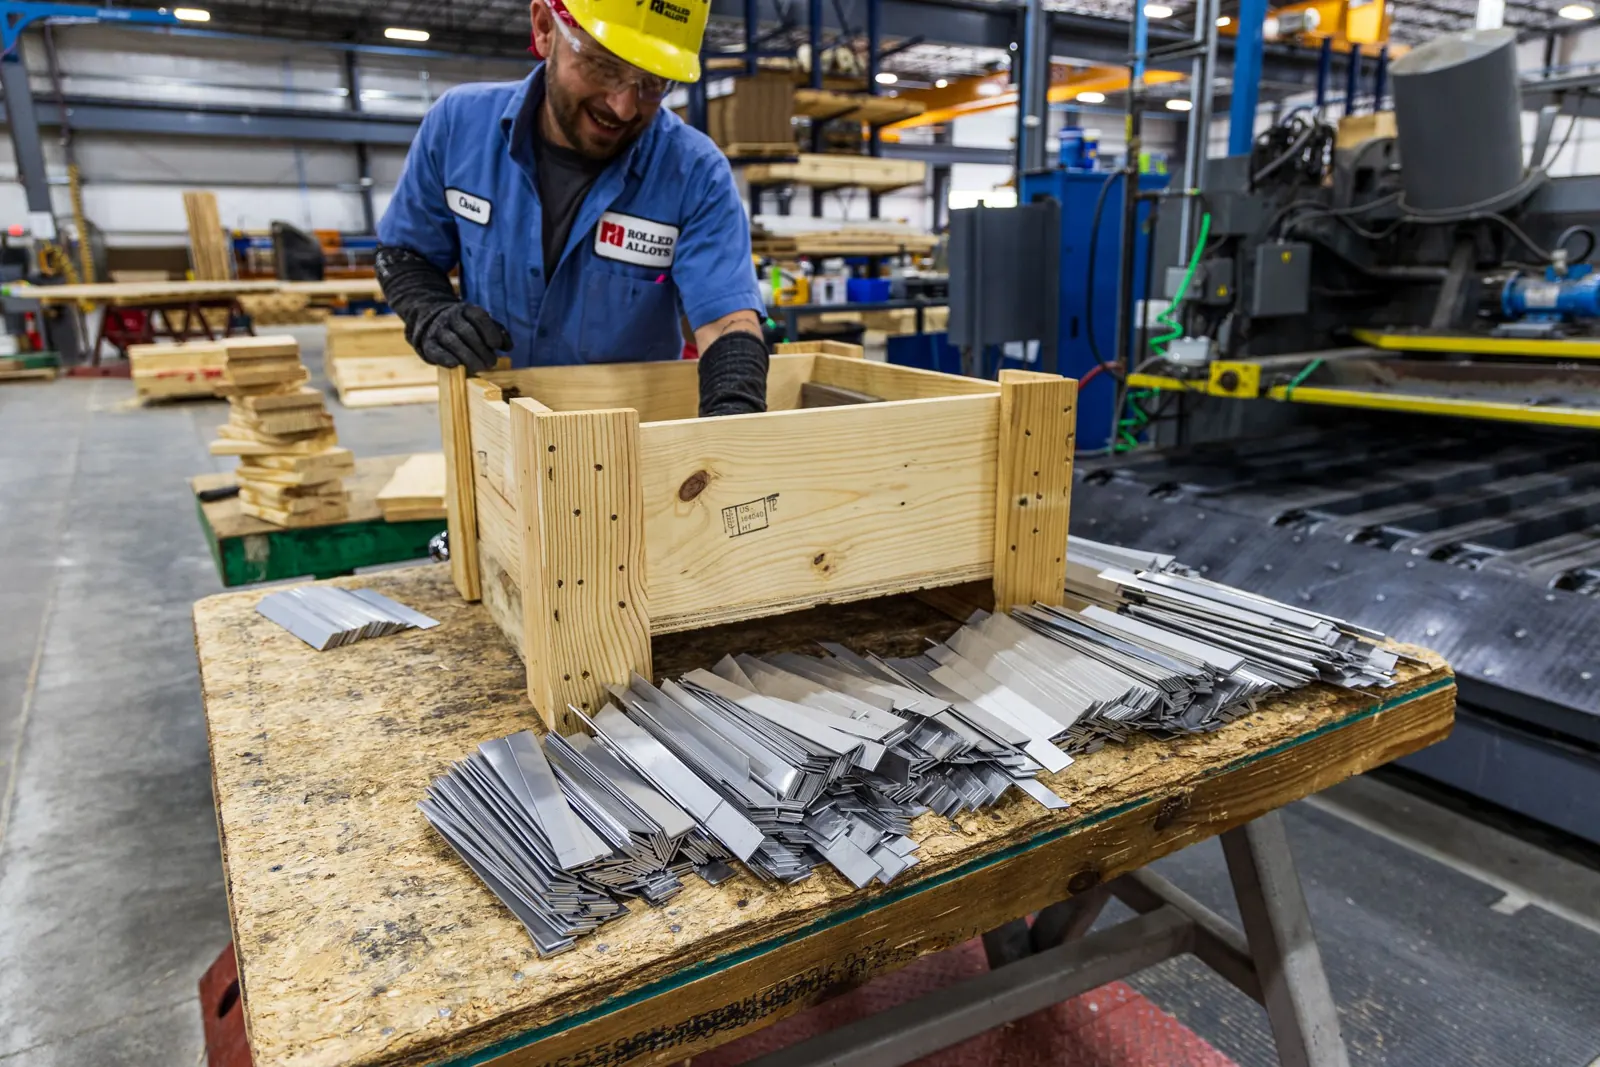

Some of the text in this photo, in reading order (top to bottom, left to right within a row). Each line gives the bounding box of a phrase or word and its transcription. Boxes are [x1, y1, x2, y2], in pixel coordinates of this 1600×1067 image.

[459, 196, 481, 214] Chris
[627, 229, 674, 246] ROLLED
[625, 242, 671, 257] ALLOYS
